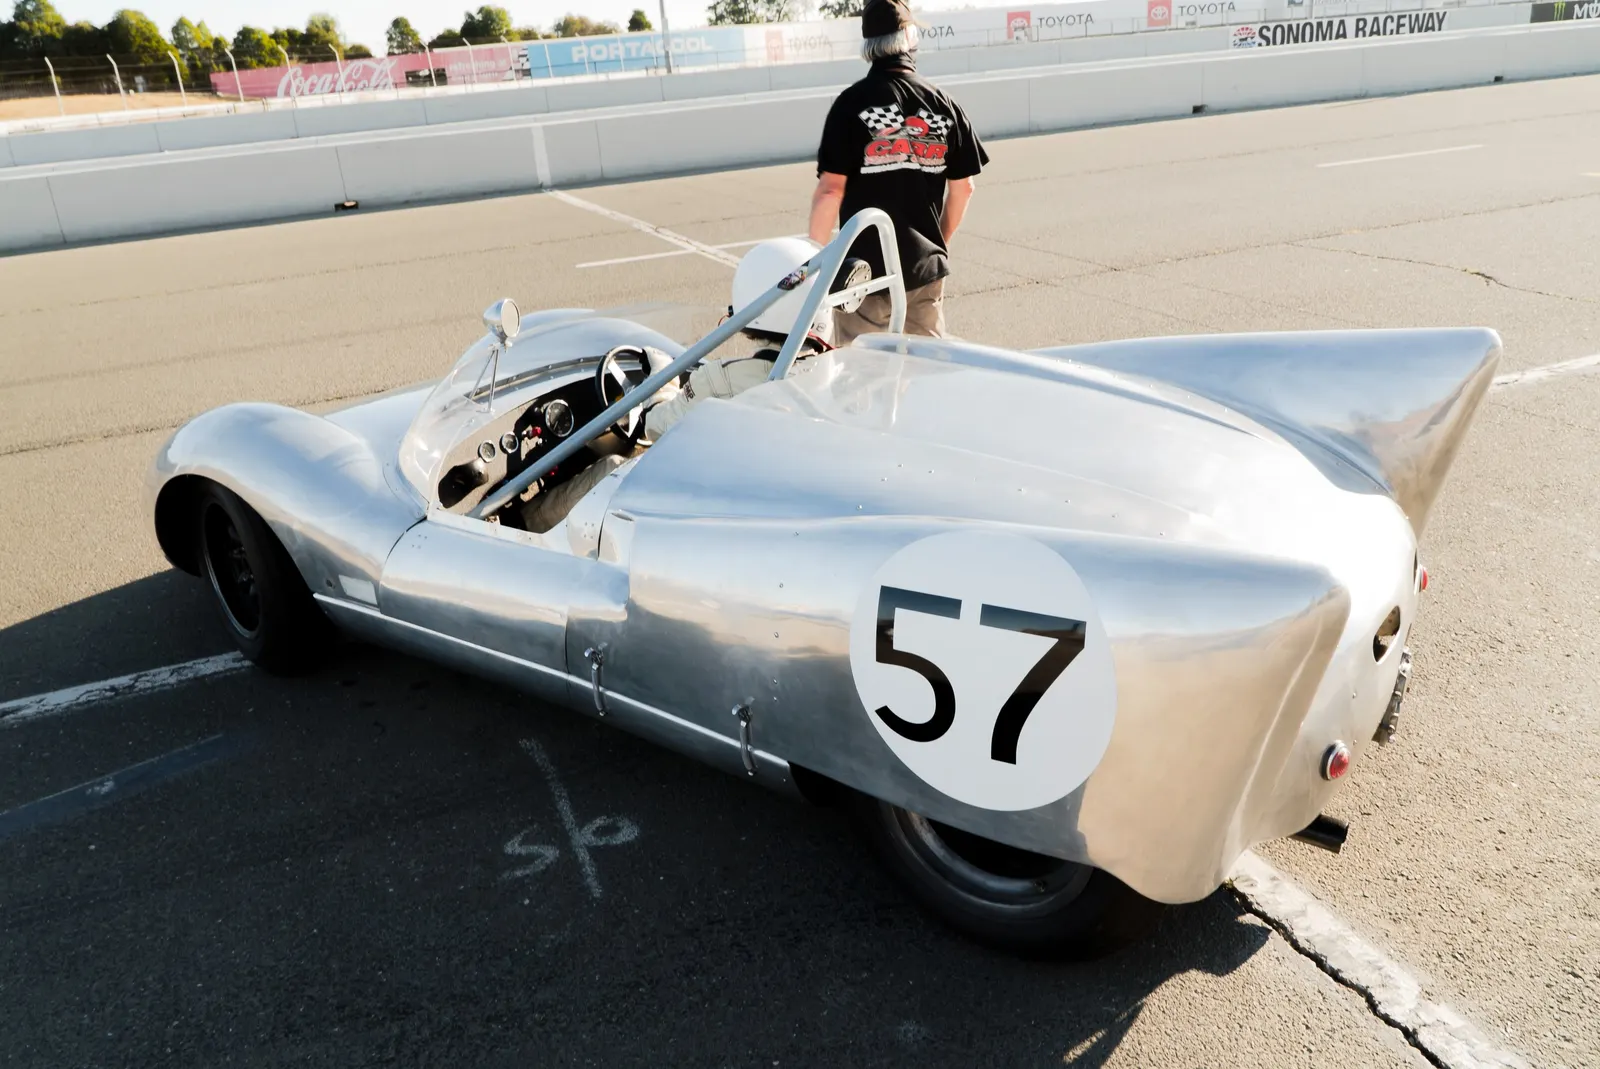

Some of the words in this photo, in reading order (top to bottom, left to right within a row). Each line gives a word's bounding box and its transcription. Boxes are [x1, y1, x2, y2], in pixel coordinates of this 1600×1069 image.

[1178, 2, 1236, 17] TOYOTA
[1037, 13, 1094, 29] TOYOTA
[1258, 19, 1347, 47] SONOMA
[1355, 11, 1447, 39] RACEWAY
[918, 25, 955, 40] YOTA
[788, 35, 833, 51] TOYOTA
[874, 585, 1087, 765] 57
